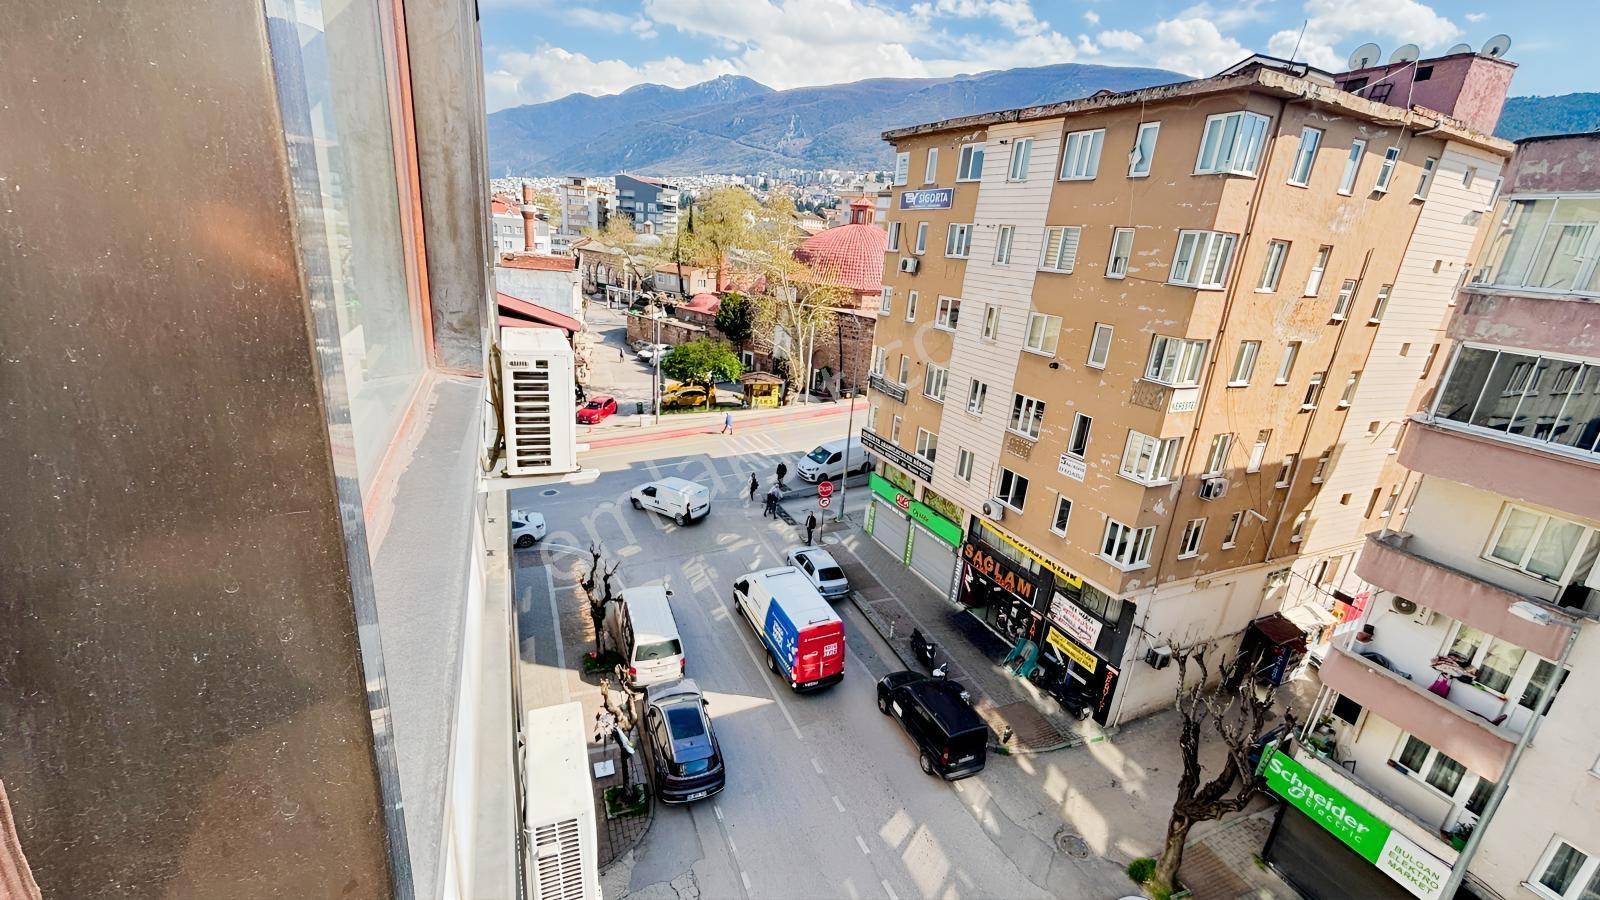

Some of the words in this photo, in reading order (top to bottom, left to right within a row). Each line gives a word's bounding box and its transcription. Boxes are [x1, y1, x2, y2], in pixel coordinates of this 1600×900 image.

[1269, 758, 1370, 833] Schneider
[1305, 797, 1362, 844] Electric
[1387, 860, 1433, 894] MARKET
[1388, 850, 1439, 890] ELEKTRO
[1394, 845, 1440, 880] BULGAN
